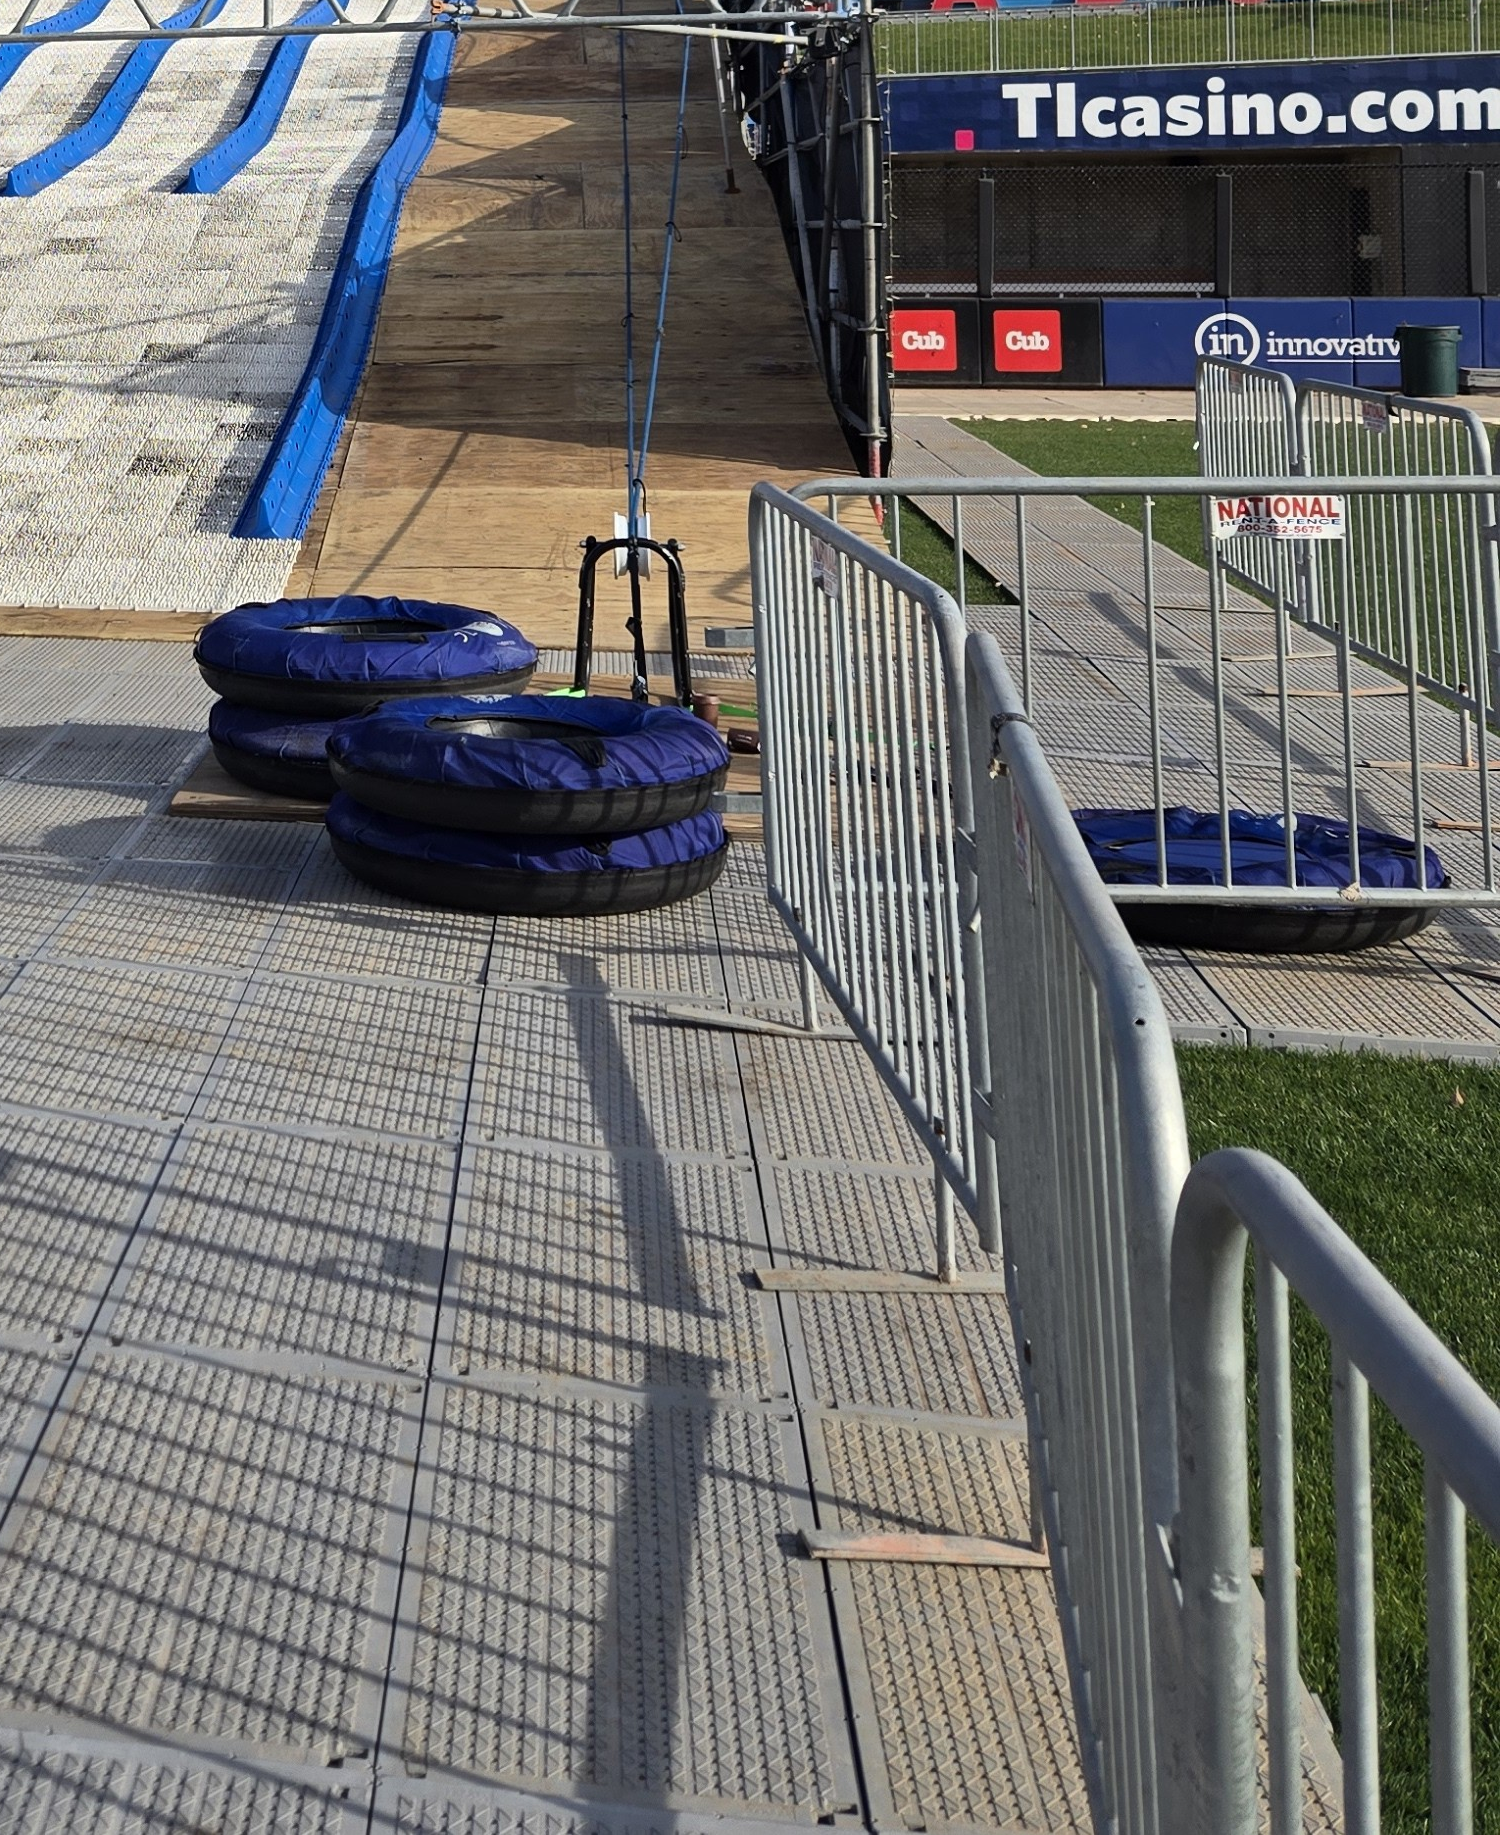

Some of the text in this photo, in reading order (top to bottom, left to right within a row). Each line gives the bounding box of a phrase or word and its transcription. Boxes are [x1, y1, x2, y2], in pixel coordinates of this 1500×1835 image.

[901, 330, 946, 351] Cub
[1005, 330, 1050, 351] Cub
[1217, 496, 1340, 522] NATIONAL
[1220, 517, 1342, 527] RENT-A-FENCE
[1237, 524, 1323, 534] 800-352-5675
